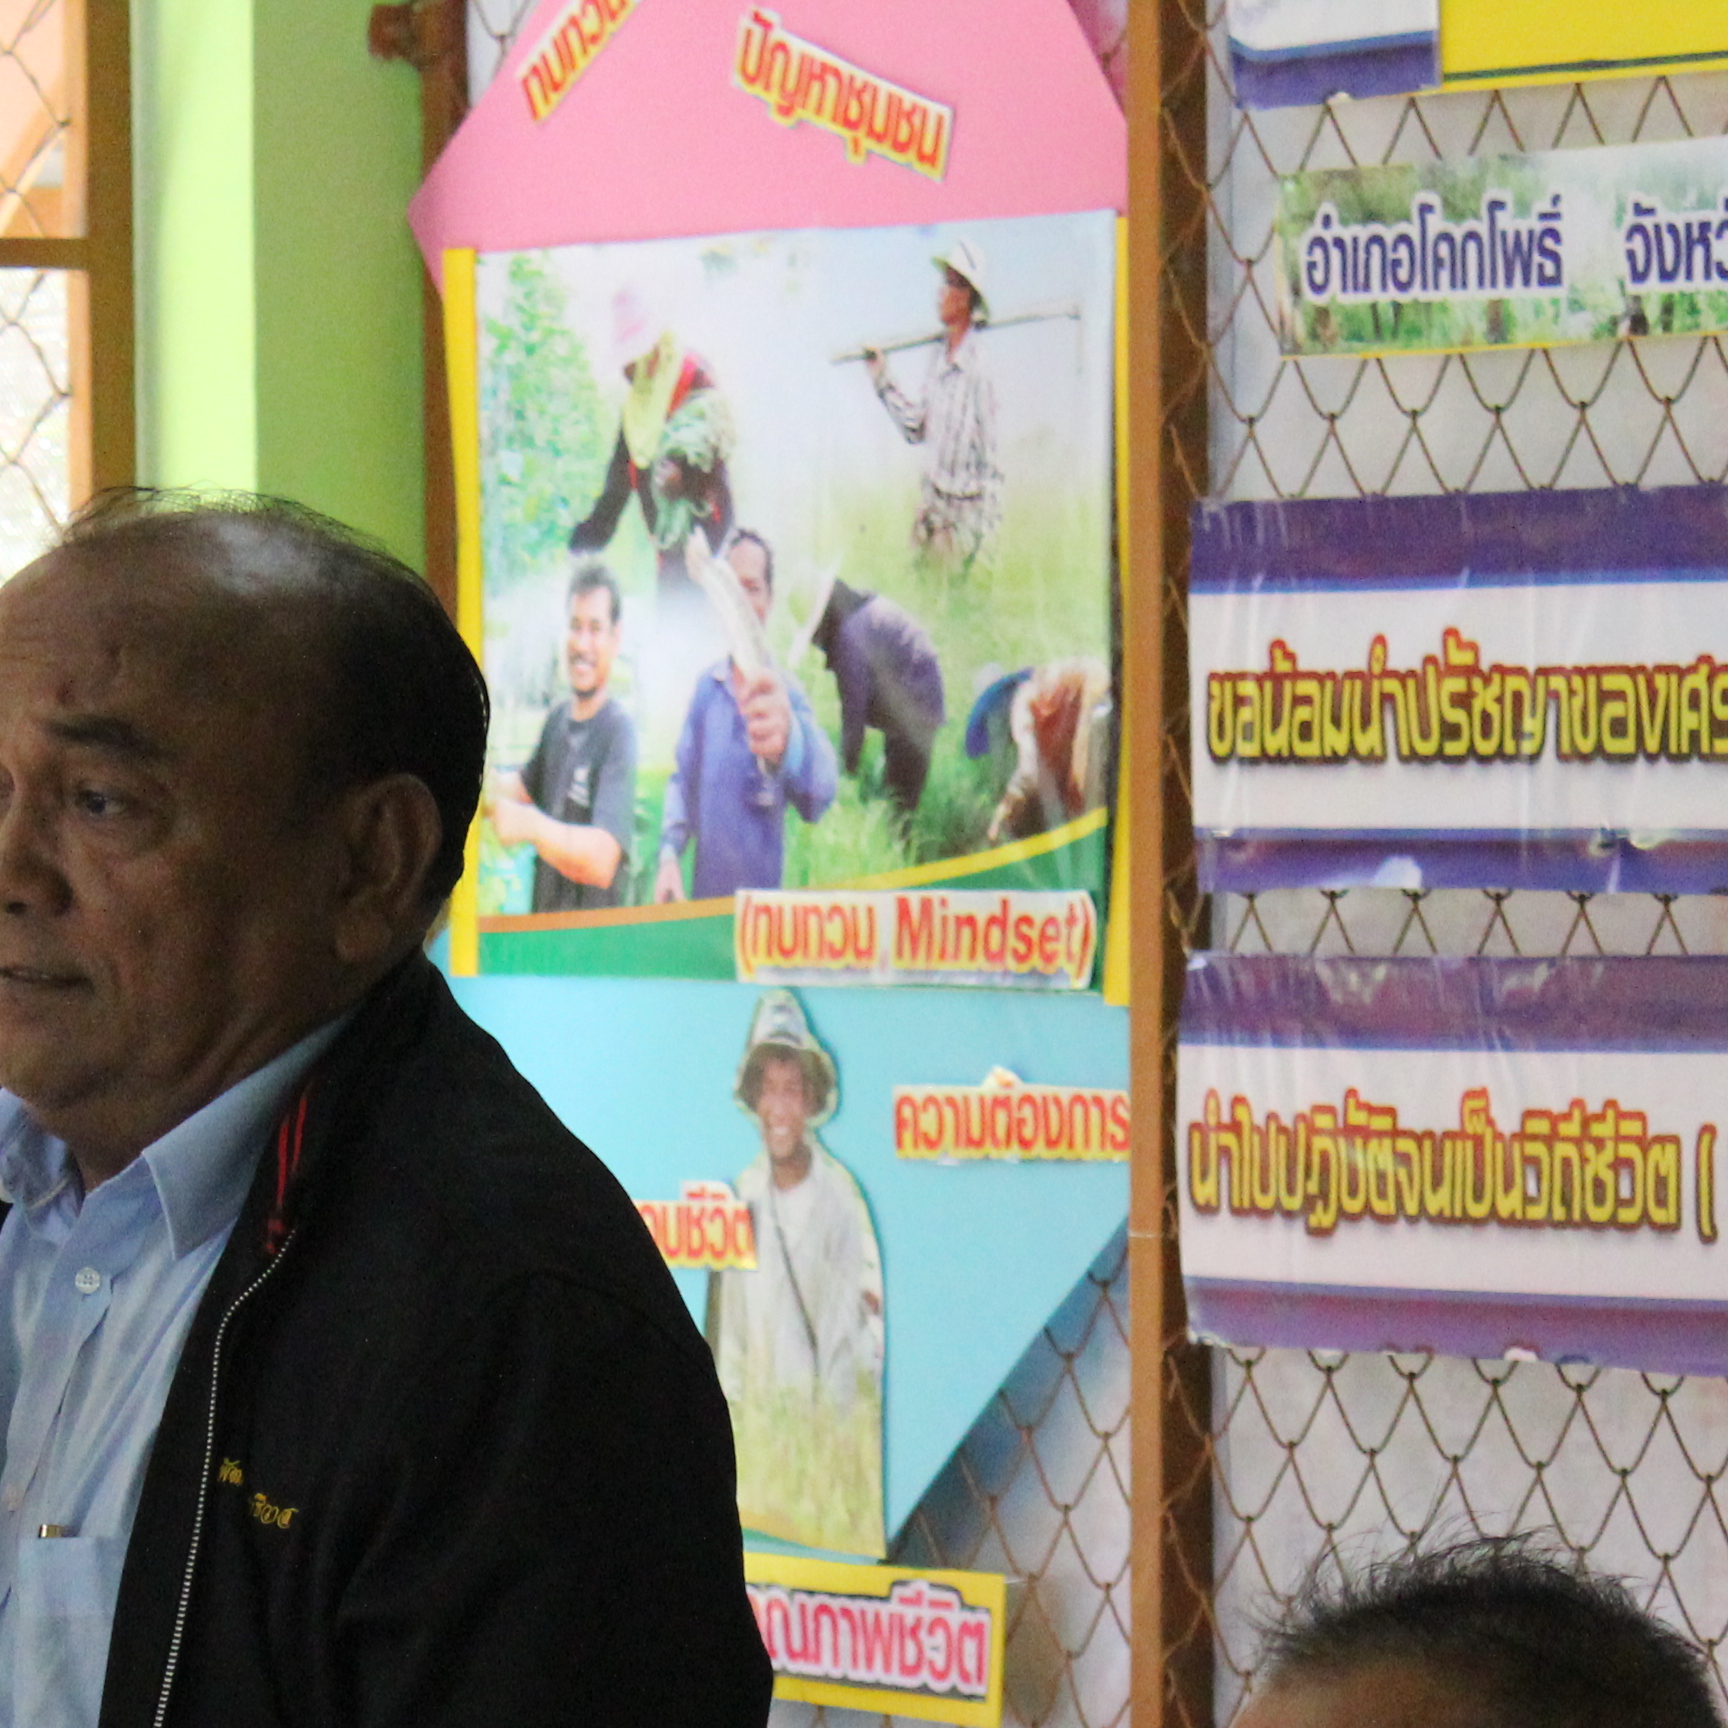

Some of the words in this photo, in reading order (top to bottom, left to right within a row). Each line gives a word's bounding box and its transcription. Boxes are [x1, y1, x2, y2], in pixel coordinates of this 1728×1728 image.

[739, 8, 946, 170] ปัญหาชุมชน
[894, 895, 1094, 980] Mindset)
[748, 1588, 987, 1687] ณภาพชีวิต
